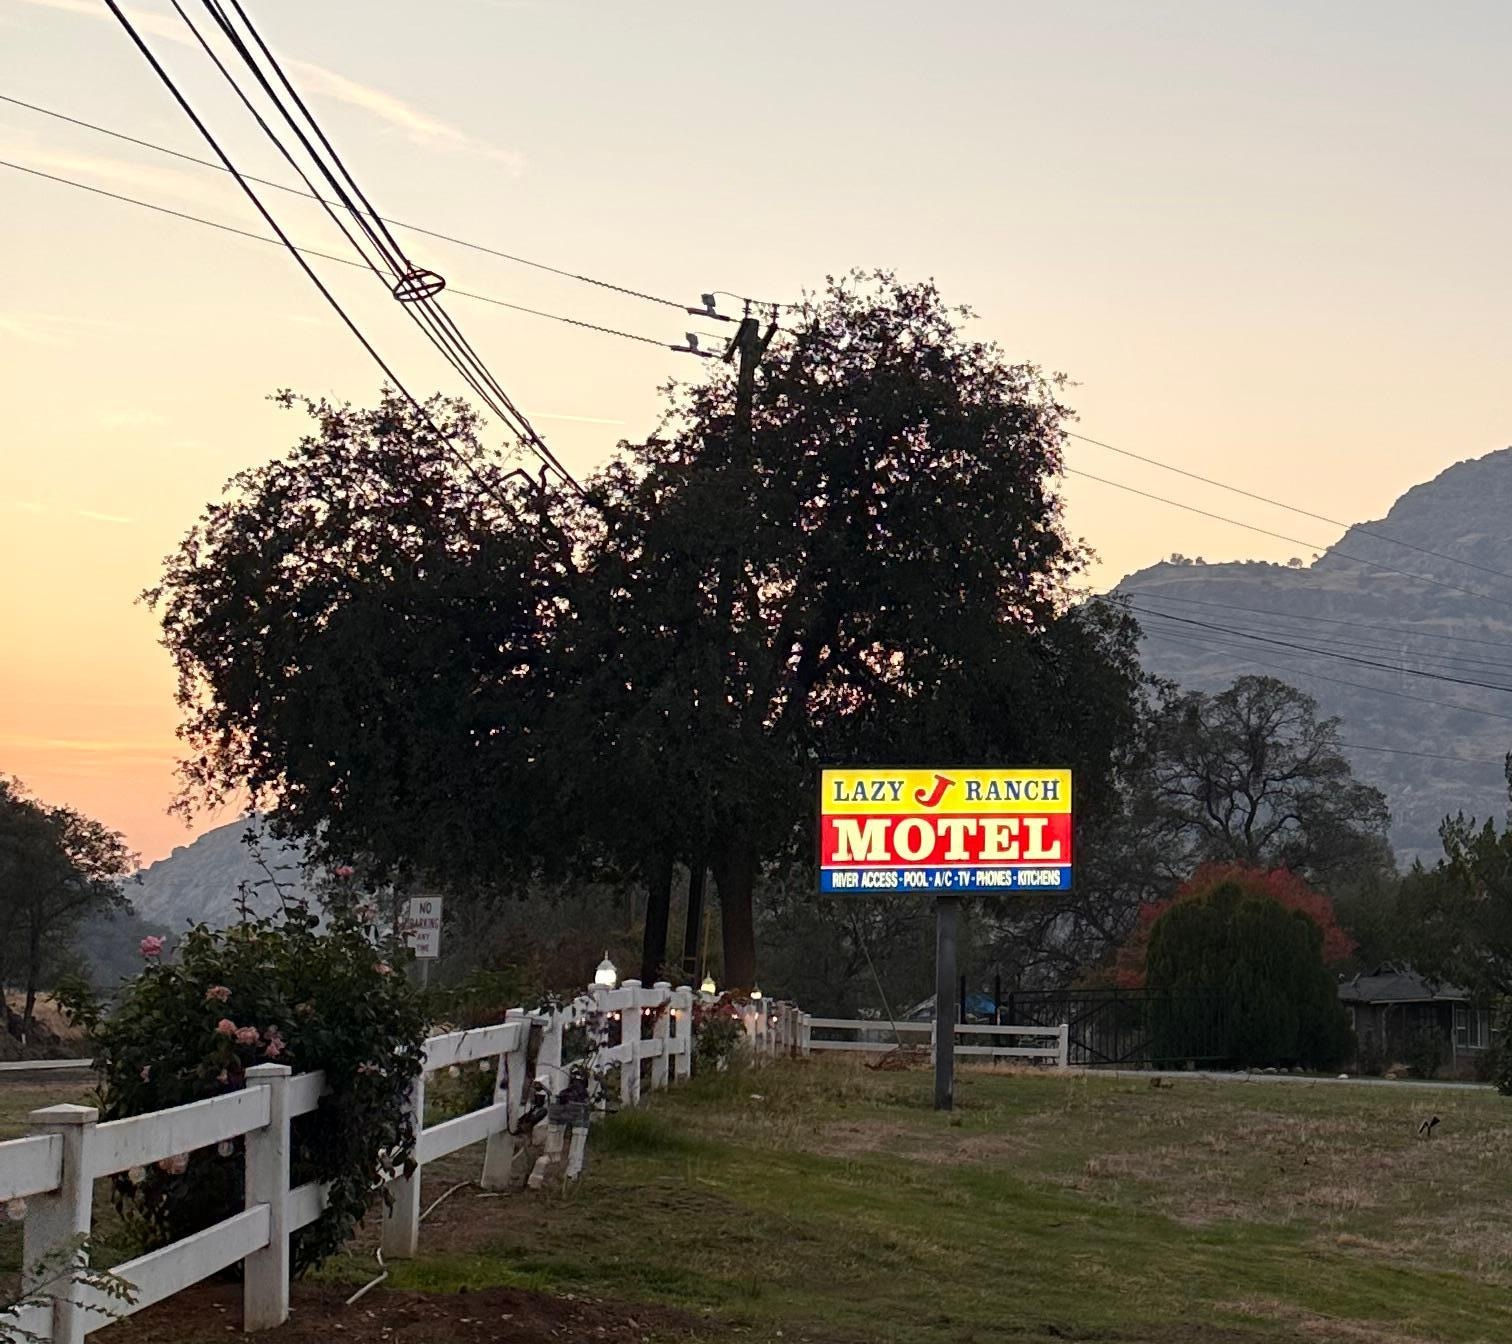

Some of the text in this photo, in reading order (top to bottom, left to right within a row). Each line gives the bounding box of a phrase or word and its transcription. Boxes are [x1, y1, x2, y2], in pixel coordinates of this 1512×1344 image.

[834, 774, 1060, 808] LAZY J RANCH
[831, 817, 1061, 862] MOTEL
[832, 869, 1061, 888] RIVER ACCESS POOL A/C TV PHONES KITCHENS
[419, 902, 432, 915] NO
